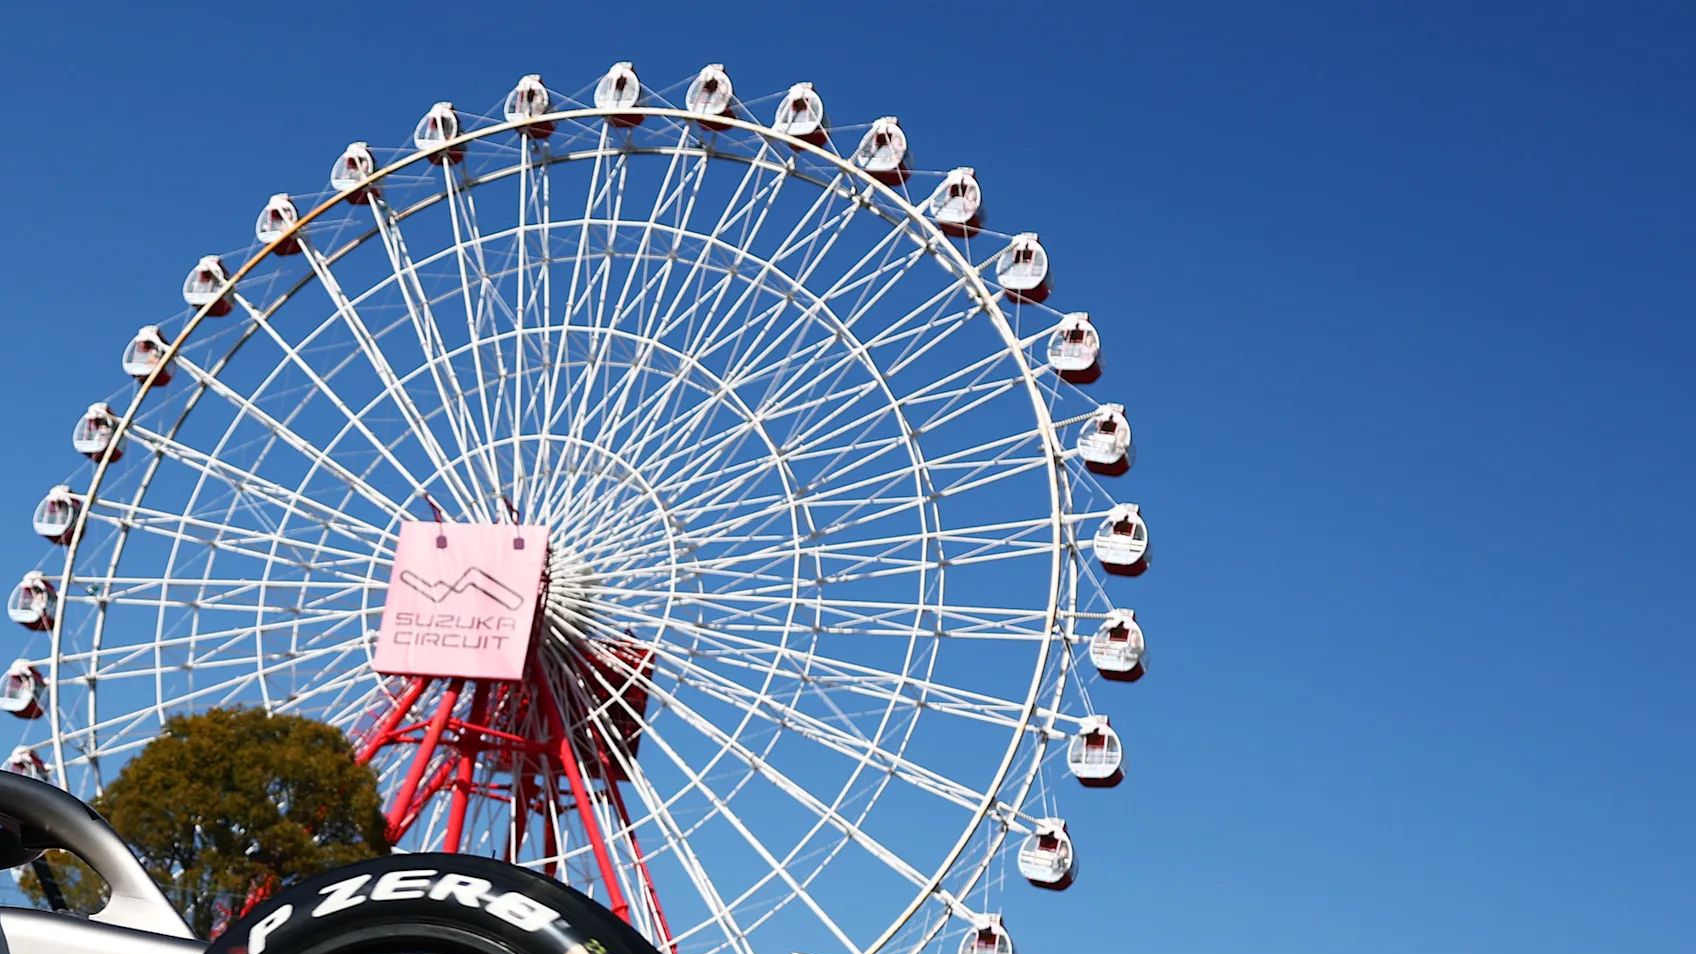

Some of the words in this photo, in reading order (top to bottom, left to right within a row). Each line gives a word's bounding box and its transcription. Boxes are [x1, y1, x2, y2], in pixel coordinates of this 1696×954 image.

[395, 612, 517, 631] SUZUKA
[393, 630, 510, 650] CIRCUIT
[311, 869, 561, 933] ZERO
